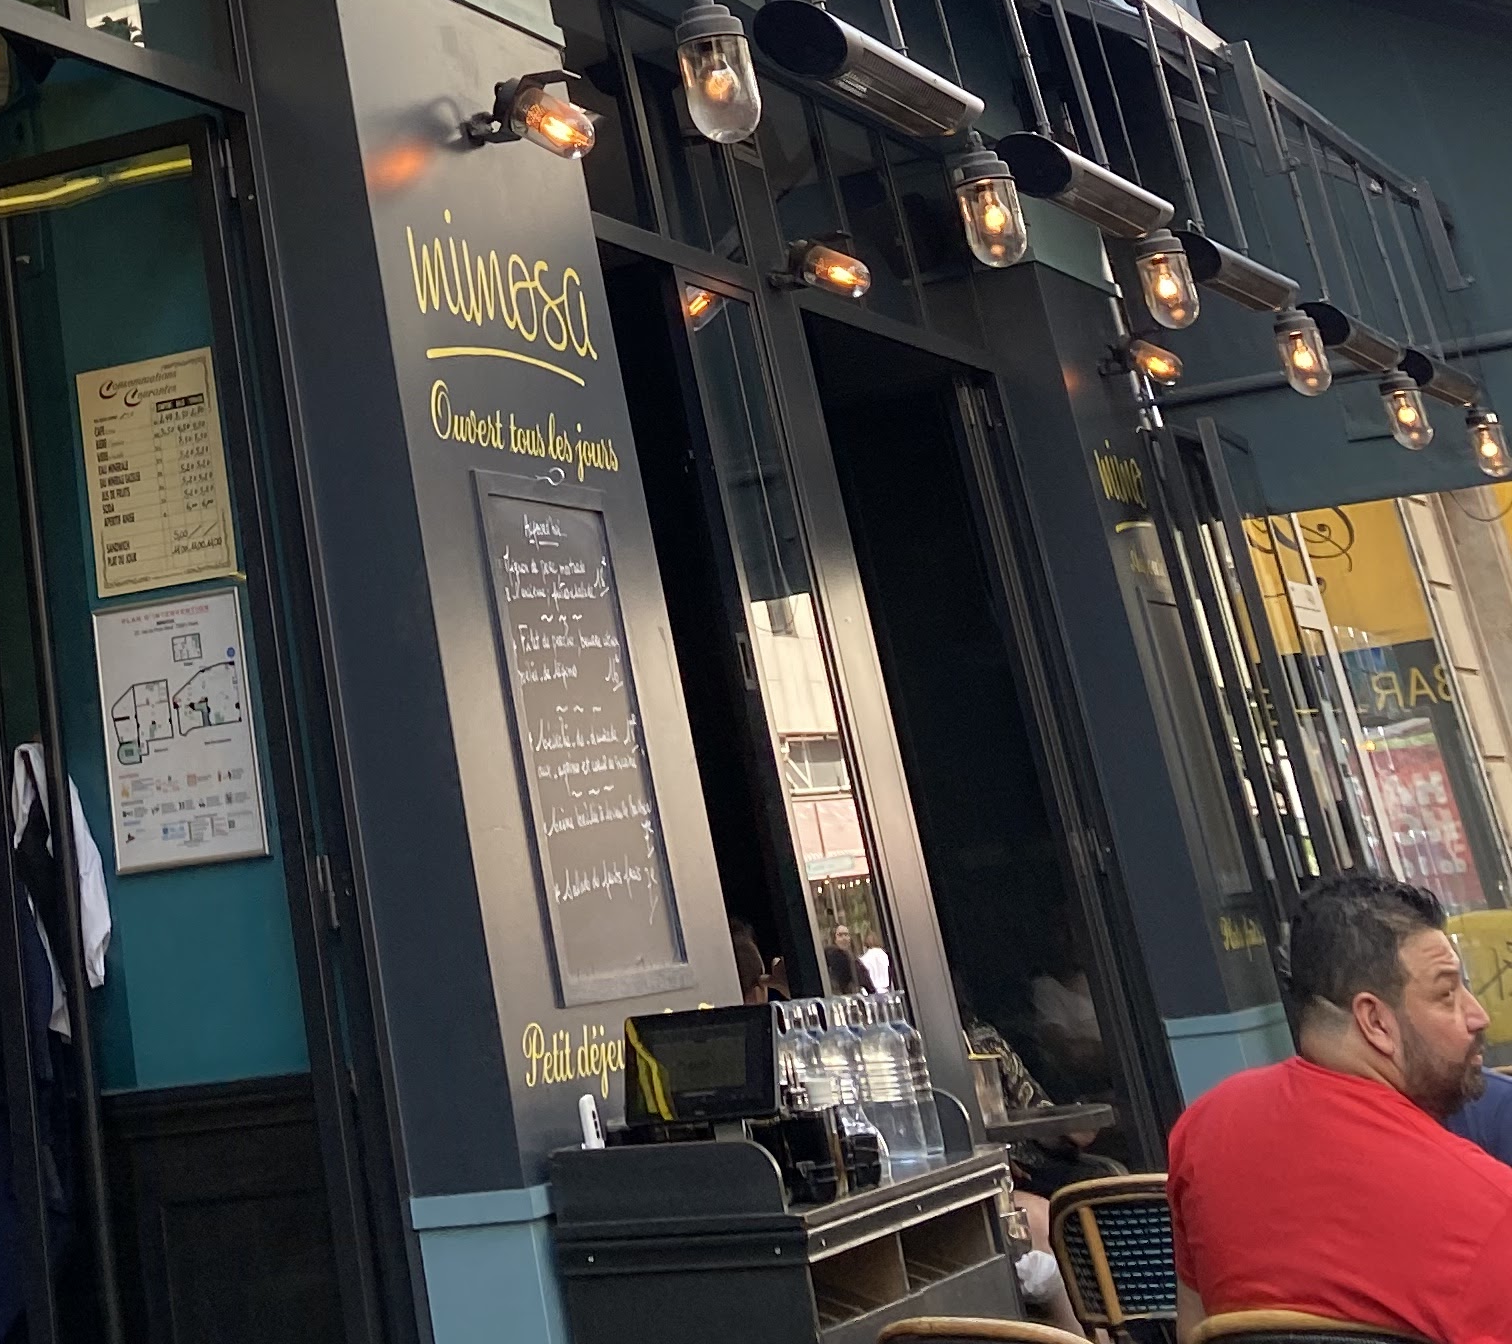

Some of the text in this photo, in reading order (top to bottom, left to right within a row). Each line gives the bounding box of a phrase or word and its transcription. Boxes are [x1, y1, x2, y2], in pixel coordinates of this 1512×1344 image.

[406, 209, 598, 361] mimosa
[431, 379, 619, 483] Ouvert tous les jours
[522, 1022, 575, 1087] Petit
